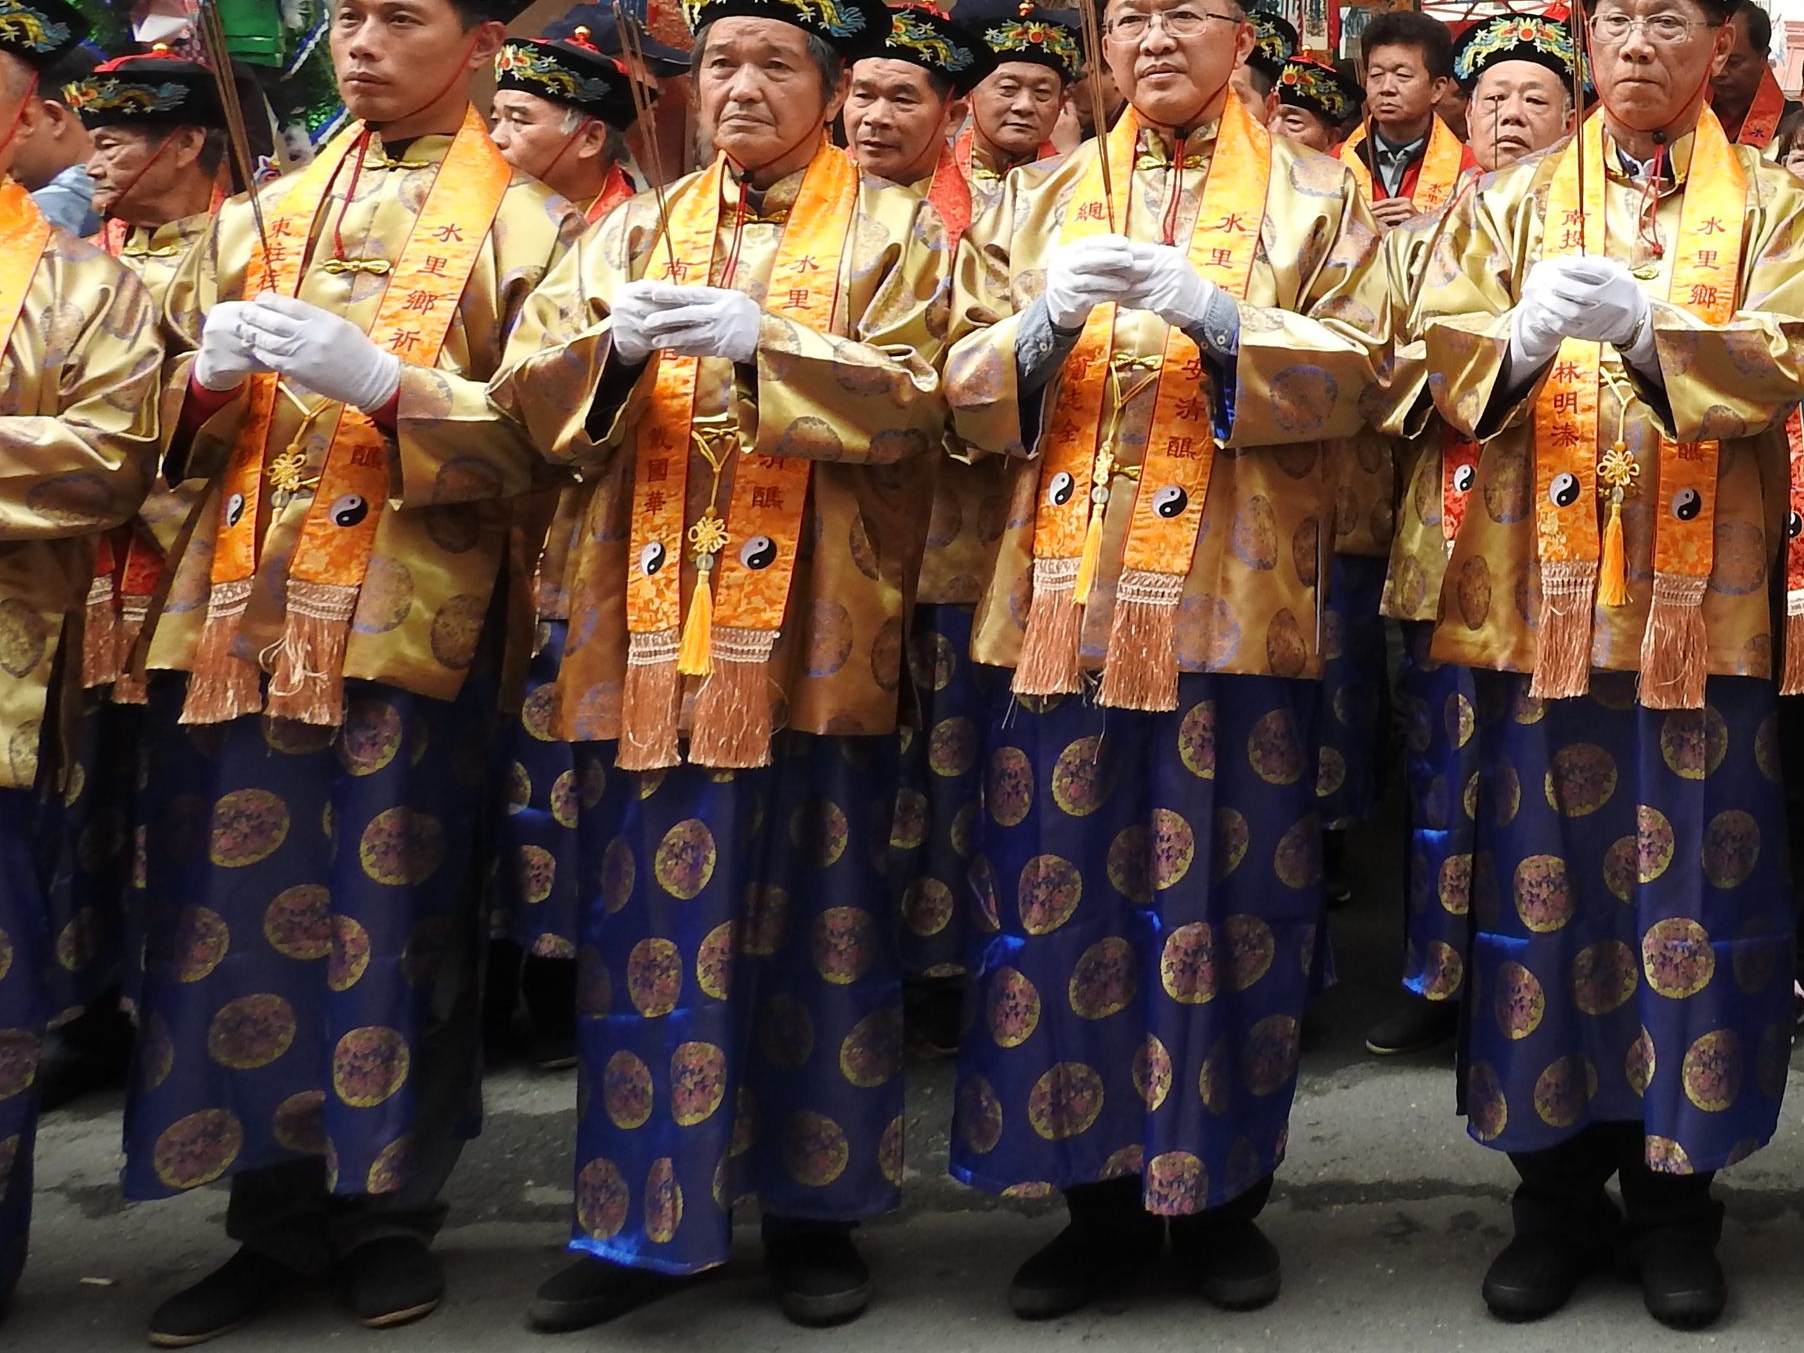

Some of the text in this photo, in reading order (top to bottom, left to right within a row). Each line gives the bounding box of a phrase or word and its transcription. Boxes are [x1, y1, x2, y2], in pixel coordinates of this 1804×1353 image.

[661, 258, 694, 281] 南
[1204, 213, 1246, 269] 水里
[1687, 216, 1726, 309] 水里鄉
[388, 223, 464, 352] 水里鄉祈
[786, 255, 820, 310] 水里
[1550, 208, 1592, 447] 南投 林明溱
